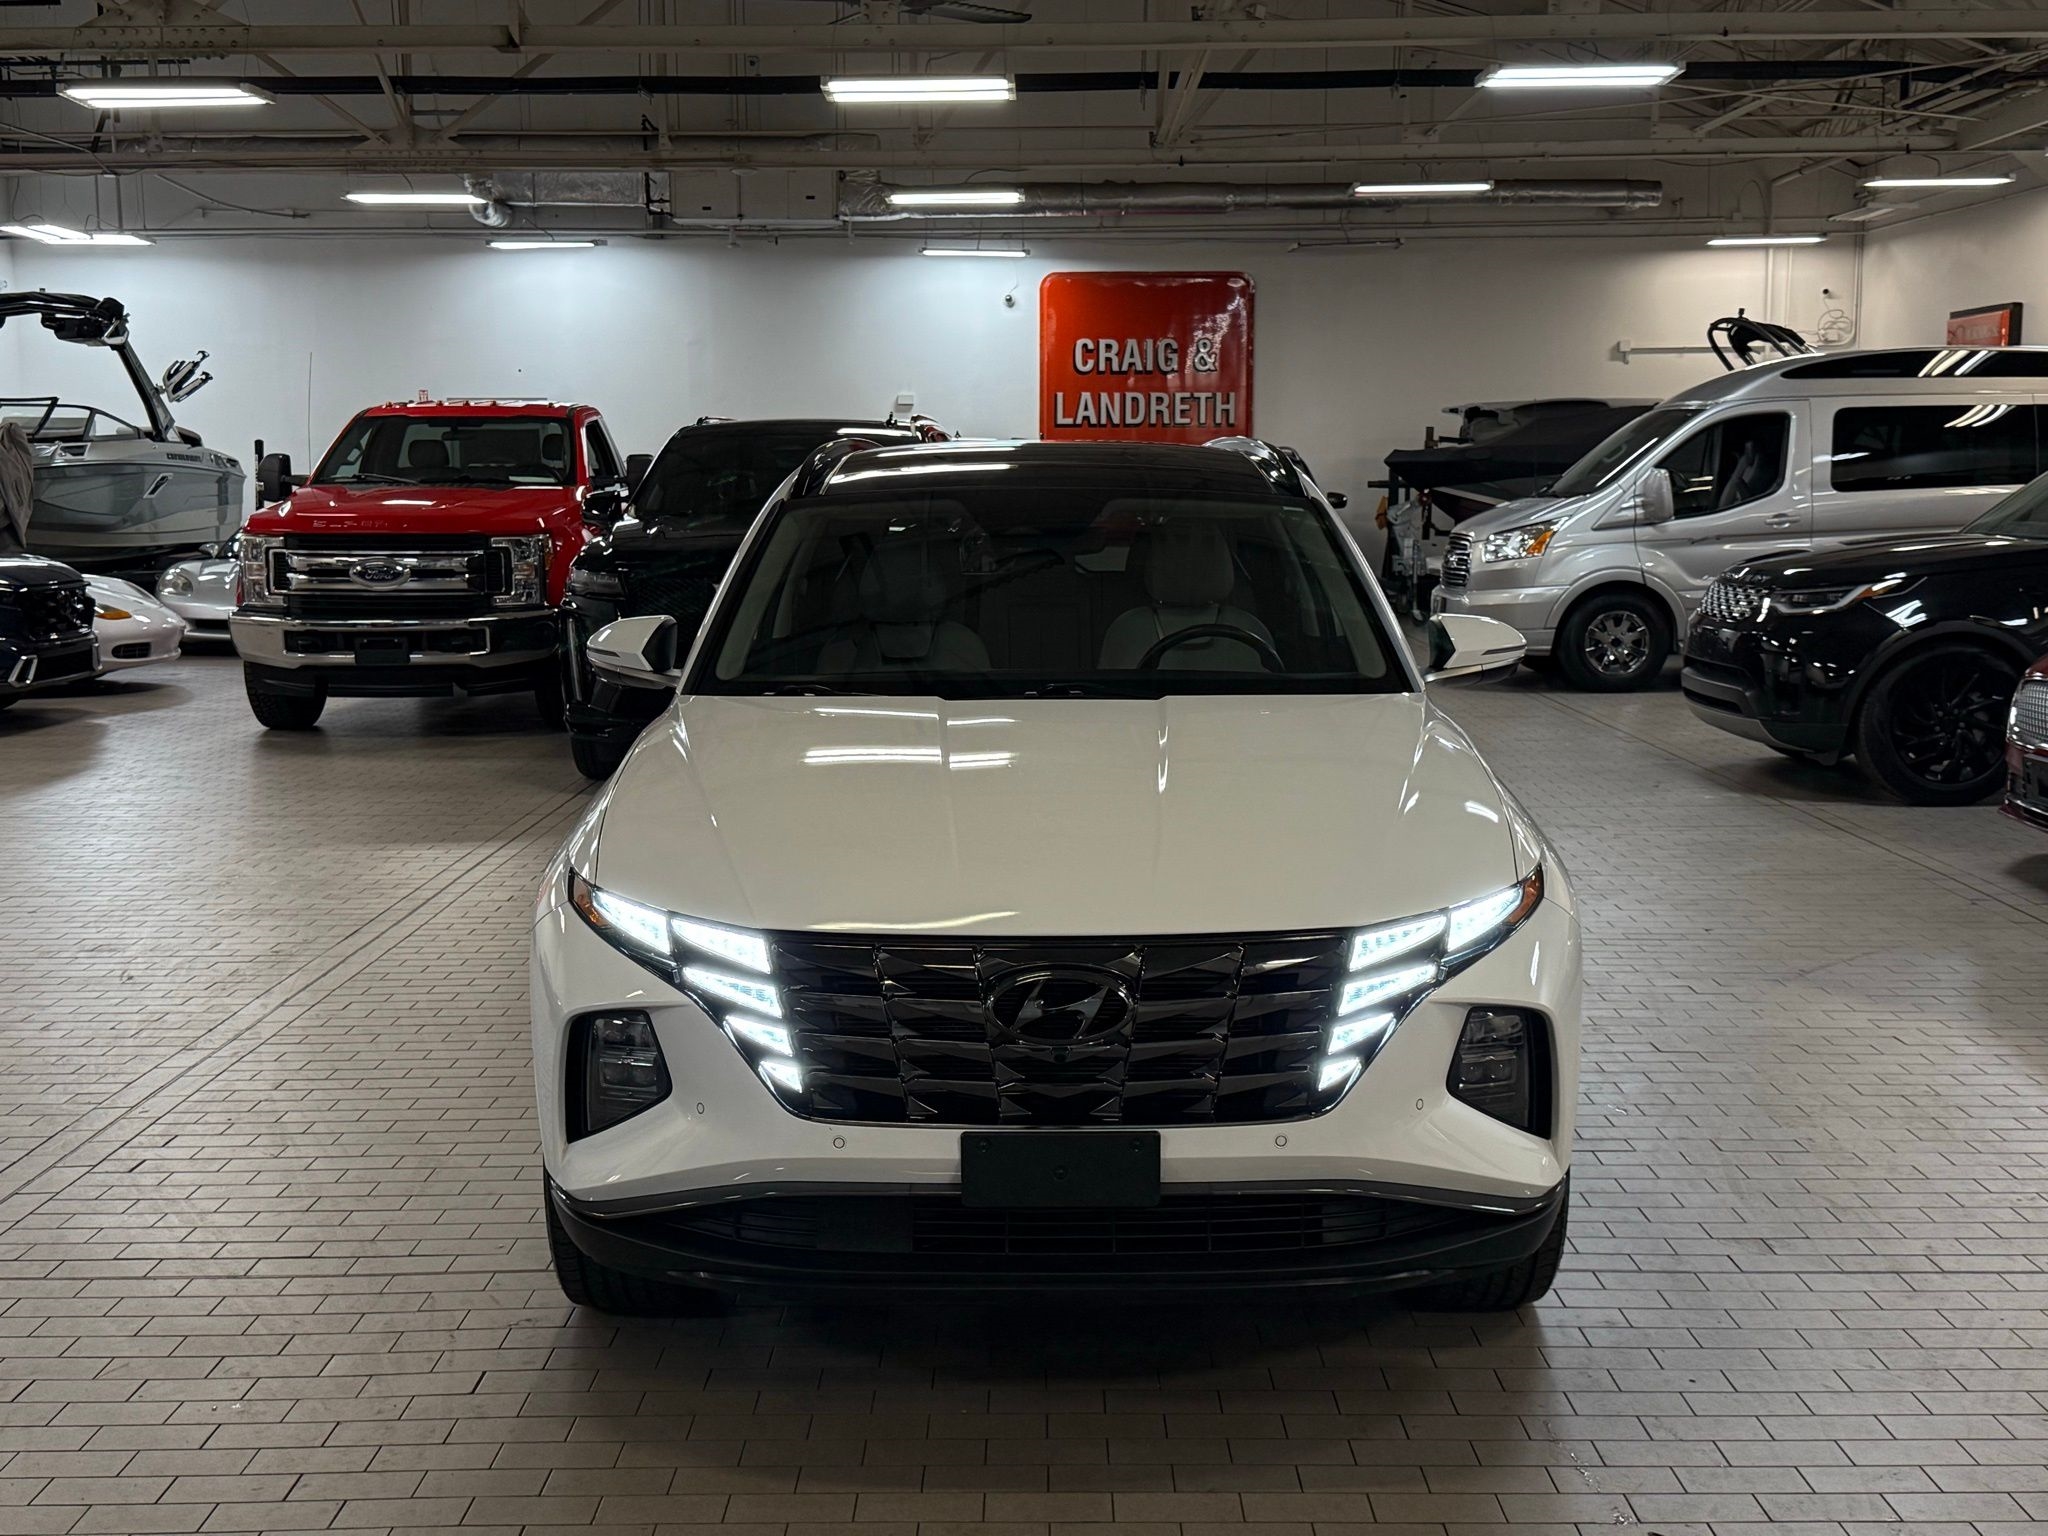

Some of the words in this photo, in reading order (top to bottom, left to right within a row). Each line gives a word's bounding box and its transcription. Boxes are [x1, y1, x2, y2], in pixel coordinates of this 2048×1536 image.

[1073, 337, 1179, 374] CRAIG
[1193, 337, 1218, 373] &
[1055, 391, 1236, 427] LANDRETH
